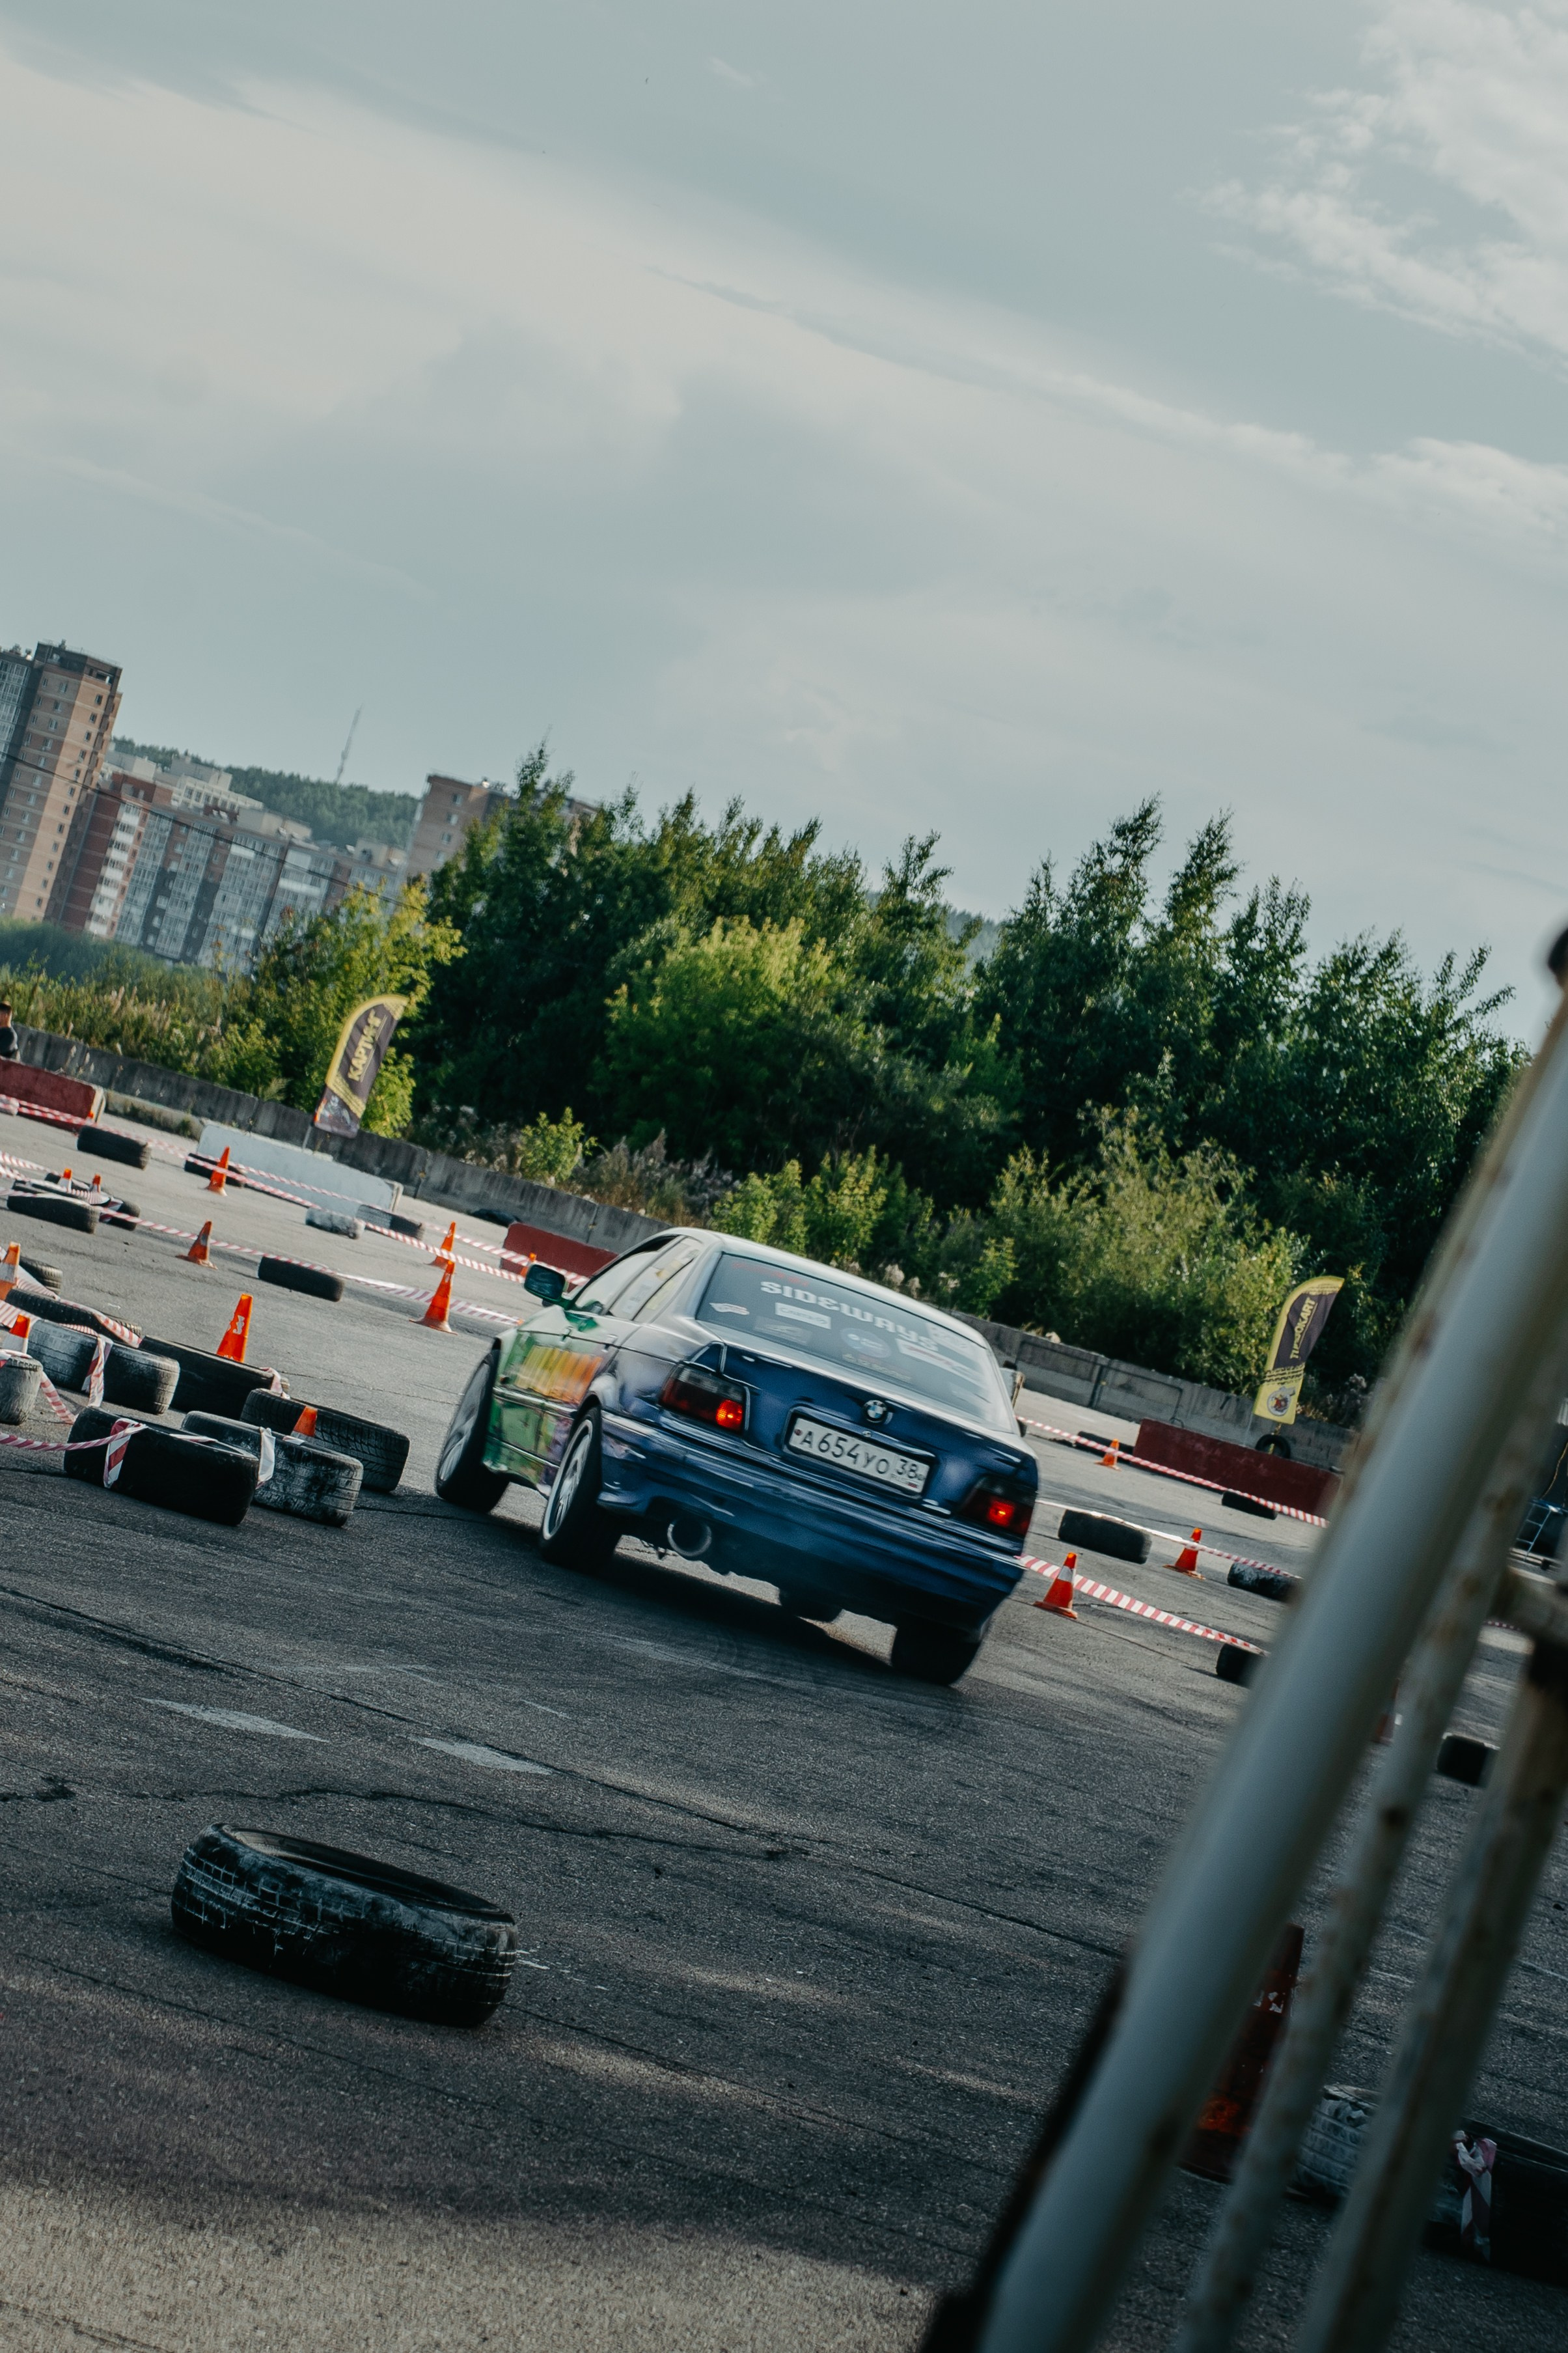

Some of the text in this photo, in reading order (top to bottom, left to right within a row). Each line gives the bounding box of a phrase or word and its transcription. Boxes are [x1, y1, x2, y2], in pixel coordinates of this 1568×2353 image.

[348, 1009, 381, 1081] КАРТИНГ
[760, 1281, 939, 1352] SIDEWAYS
[897, 1458, 918, 1479] 38
